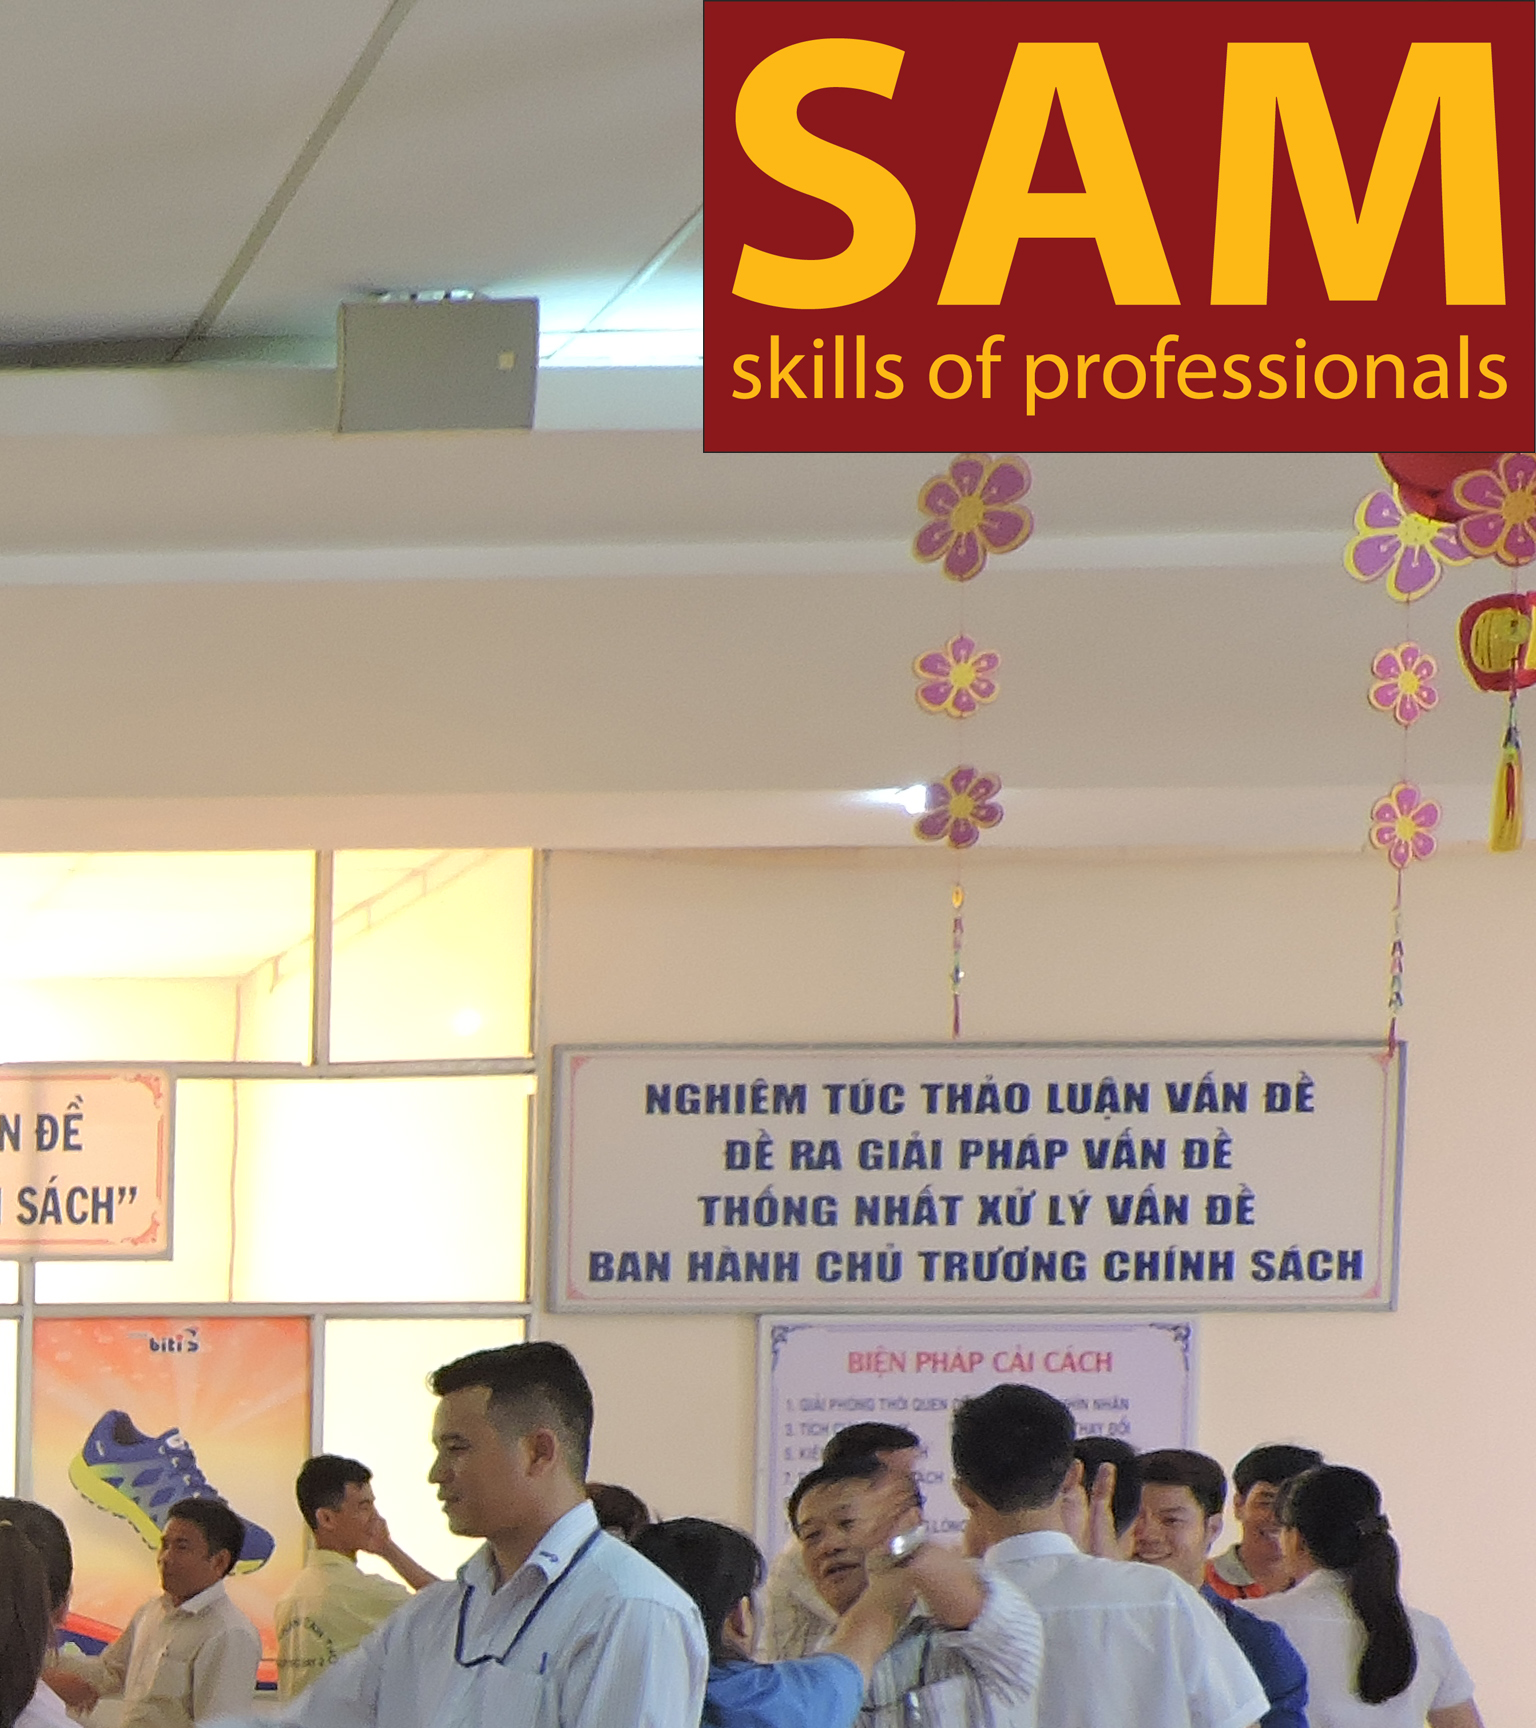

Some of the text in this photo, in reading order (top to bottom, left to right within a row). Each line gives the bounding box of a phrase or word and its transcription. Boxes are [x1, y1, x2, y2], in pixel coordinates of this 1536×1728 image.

[646, 1070, 1315, 1120] NGHIÊM TÚC THẢO LUẬN VẤN ĐỀ
[35, 1095, 84, 1152] ĐỀ
[724, 1126, 1233, 1171] ĐỀ RA GIẢI PHÁP VẤN ĐỀ
[697, 1182, 1256, 1227] THỐNG NHẤT XỬ LÝ VẤN ĐỀ
[588, 1243, 1363, 1283] BAN HÀNH CHỦ TRƯƠNG CHÍNH SÁCH
[847, 1344, 1113, 1378] BIỆN PHÁP CẢI CÁCH
